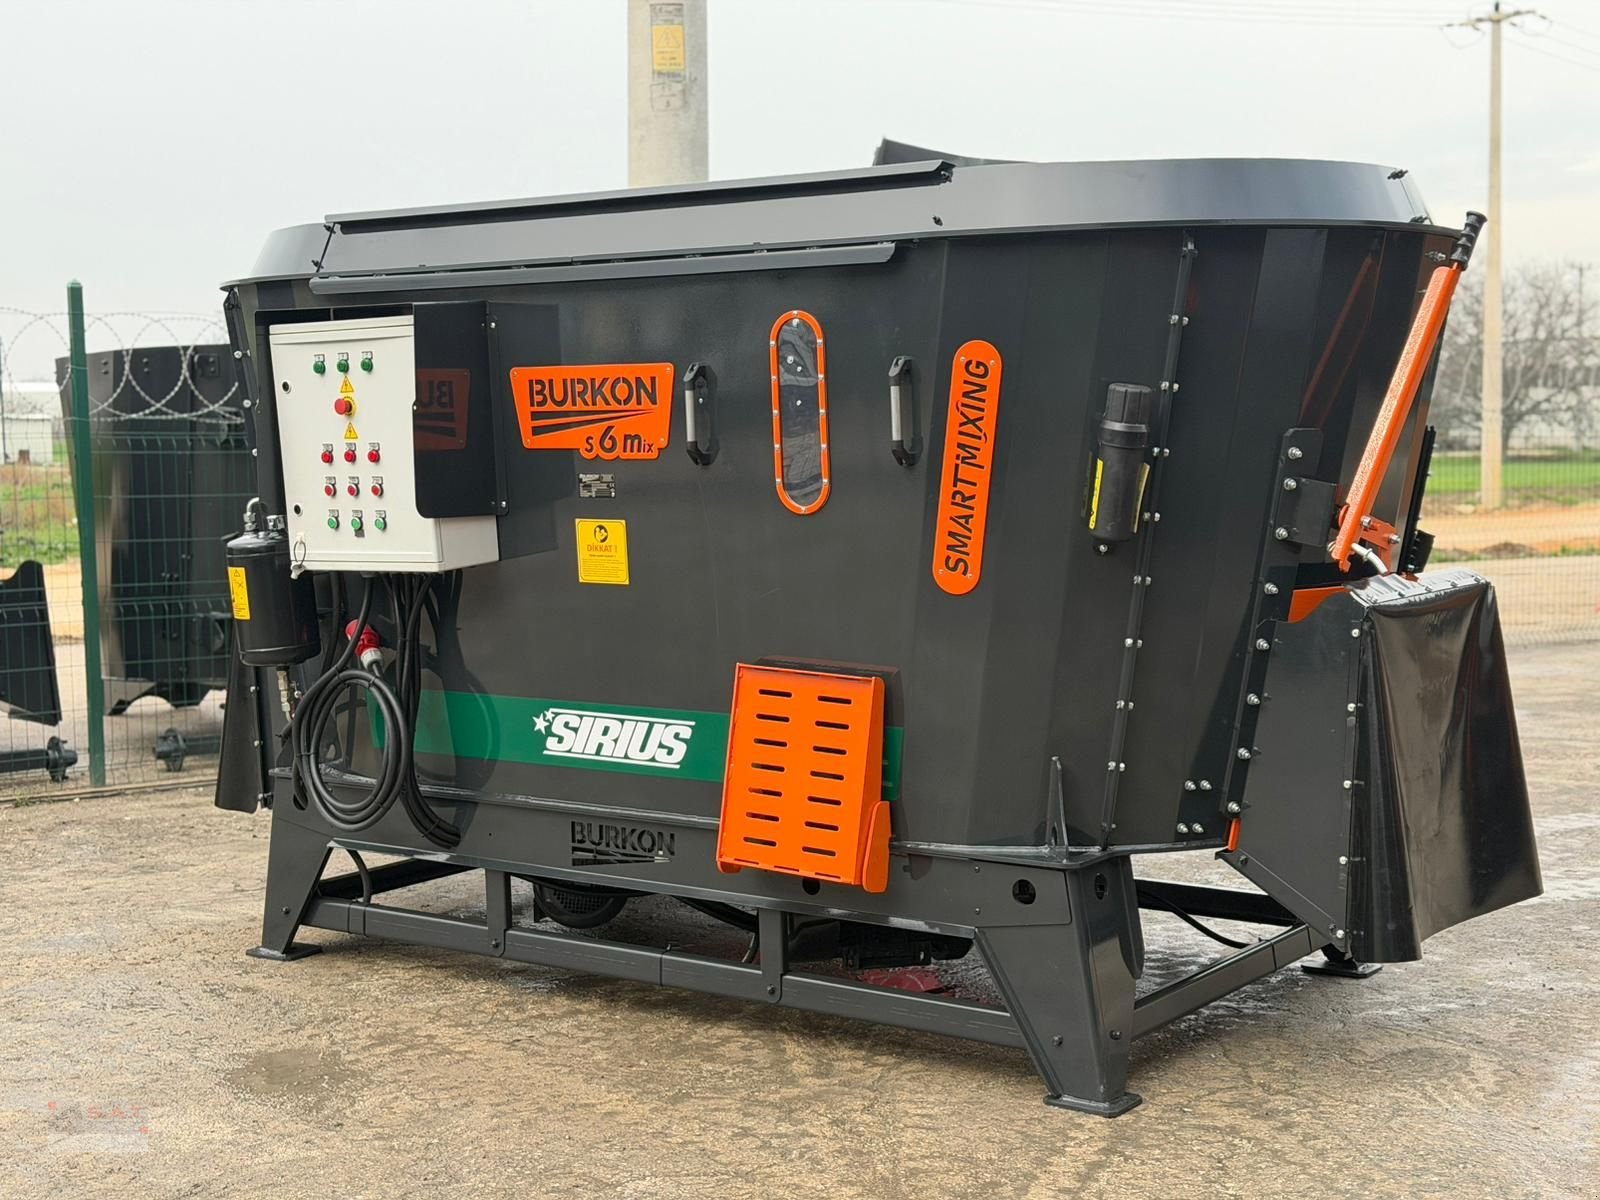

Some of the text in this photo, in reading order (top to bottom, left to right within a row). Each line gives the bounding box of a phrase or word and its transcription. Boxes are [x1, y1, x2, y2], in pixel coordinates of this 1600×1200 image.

[528, 376, 657, 408] BURKON
[545, 714, 693, 764] SIRIUS
[571, 821, 675, 856] BURKON
